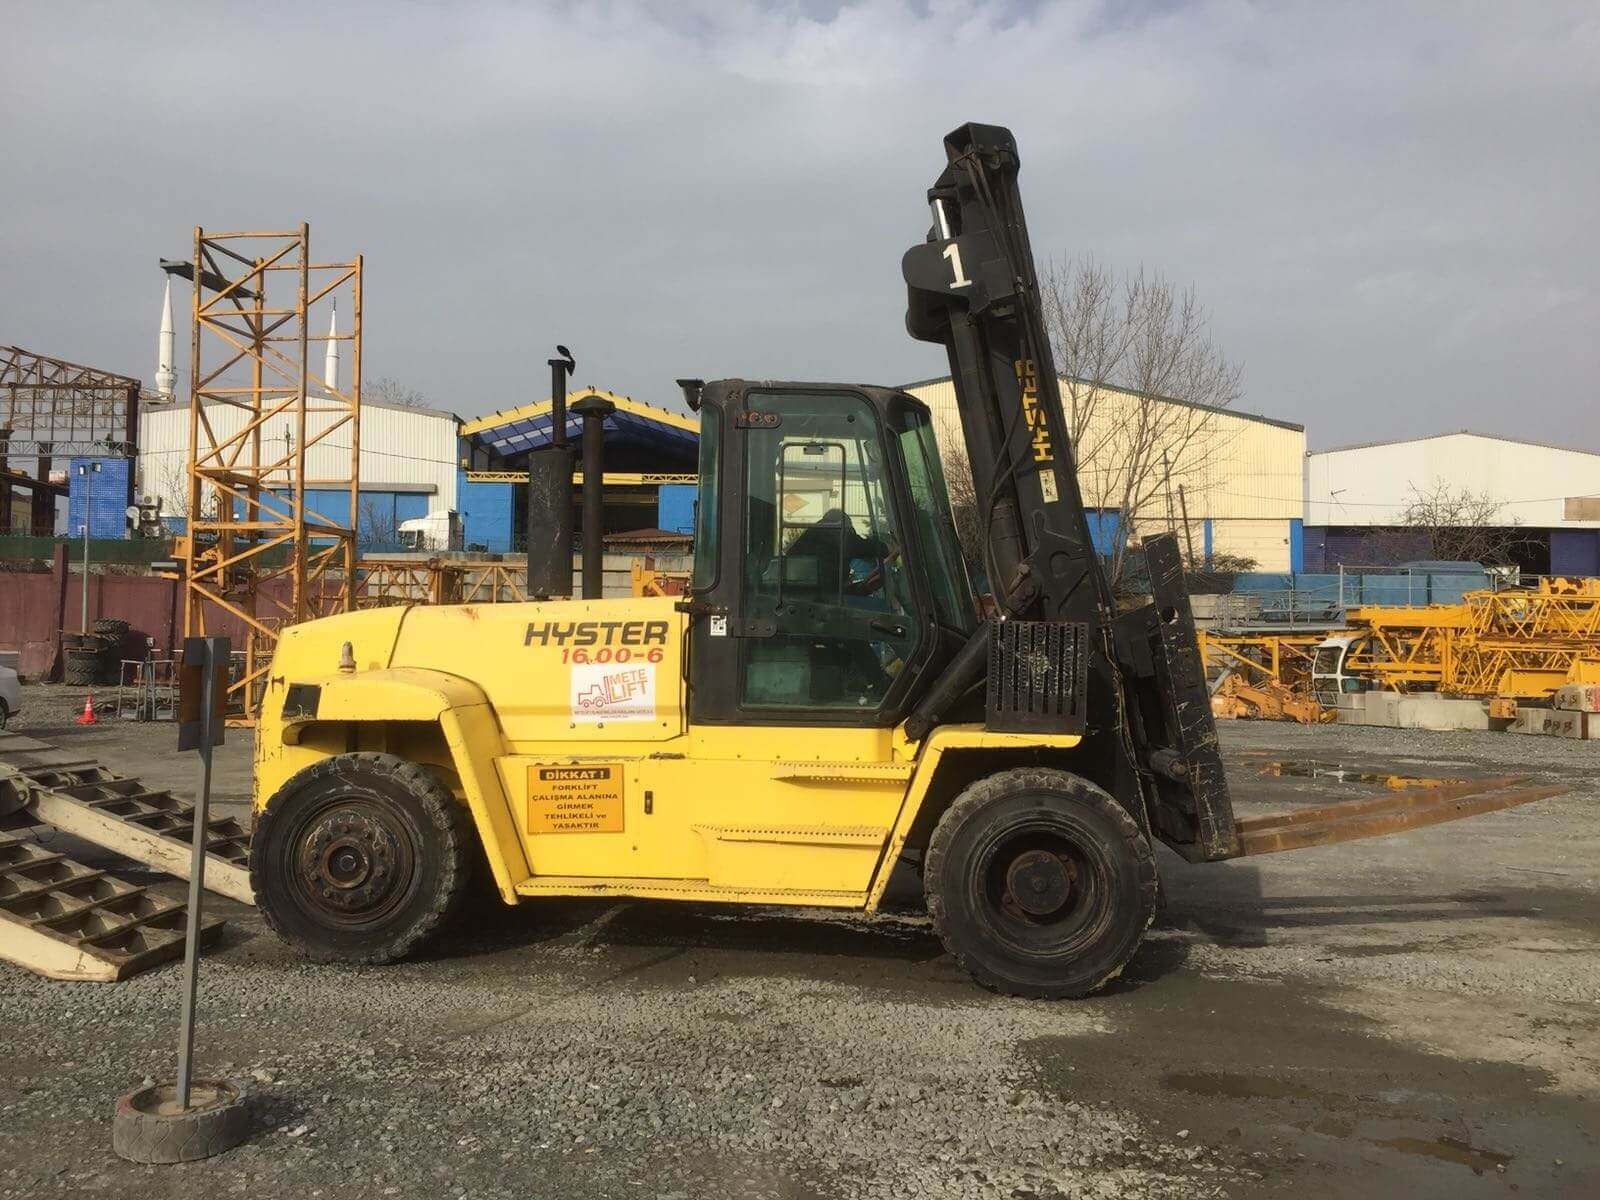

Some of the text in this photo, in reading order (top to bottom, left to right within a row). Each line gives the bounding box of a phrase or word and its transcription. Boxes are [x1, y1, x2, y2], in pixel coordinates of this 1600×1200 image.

[942, 243, 973, 289] 1
[524, 620, 669, 647] HYSTER
[609, 668, 647, 685] METE
[610, 680, 648, 700] LIFT
[545, 769, 597, 780] DİKKAT
[556, 802, 594, 810] GİRMEK
